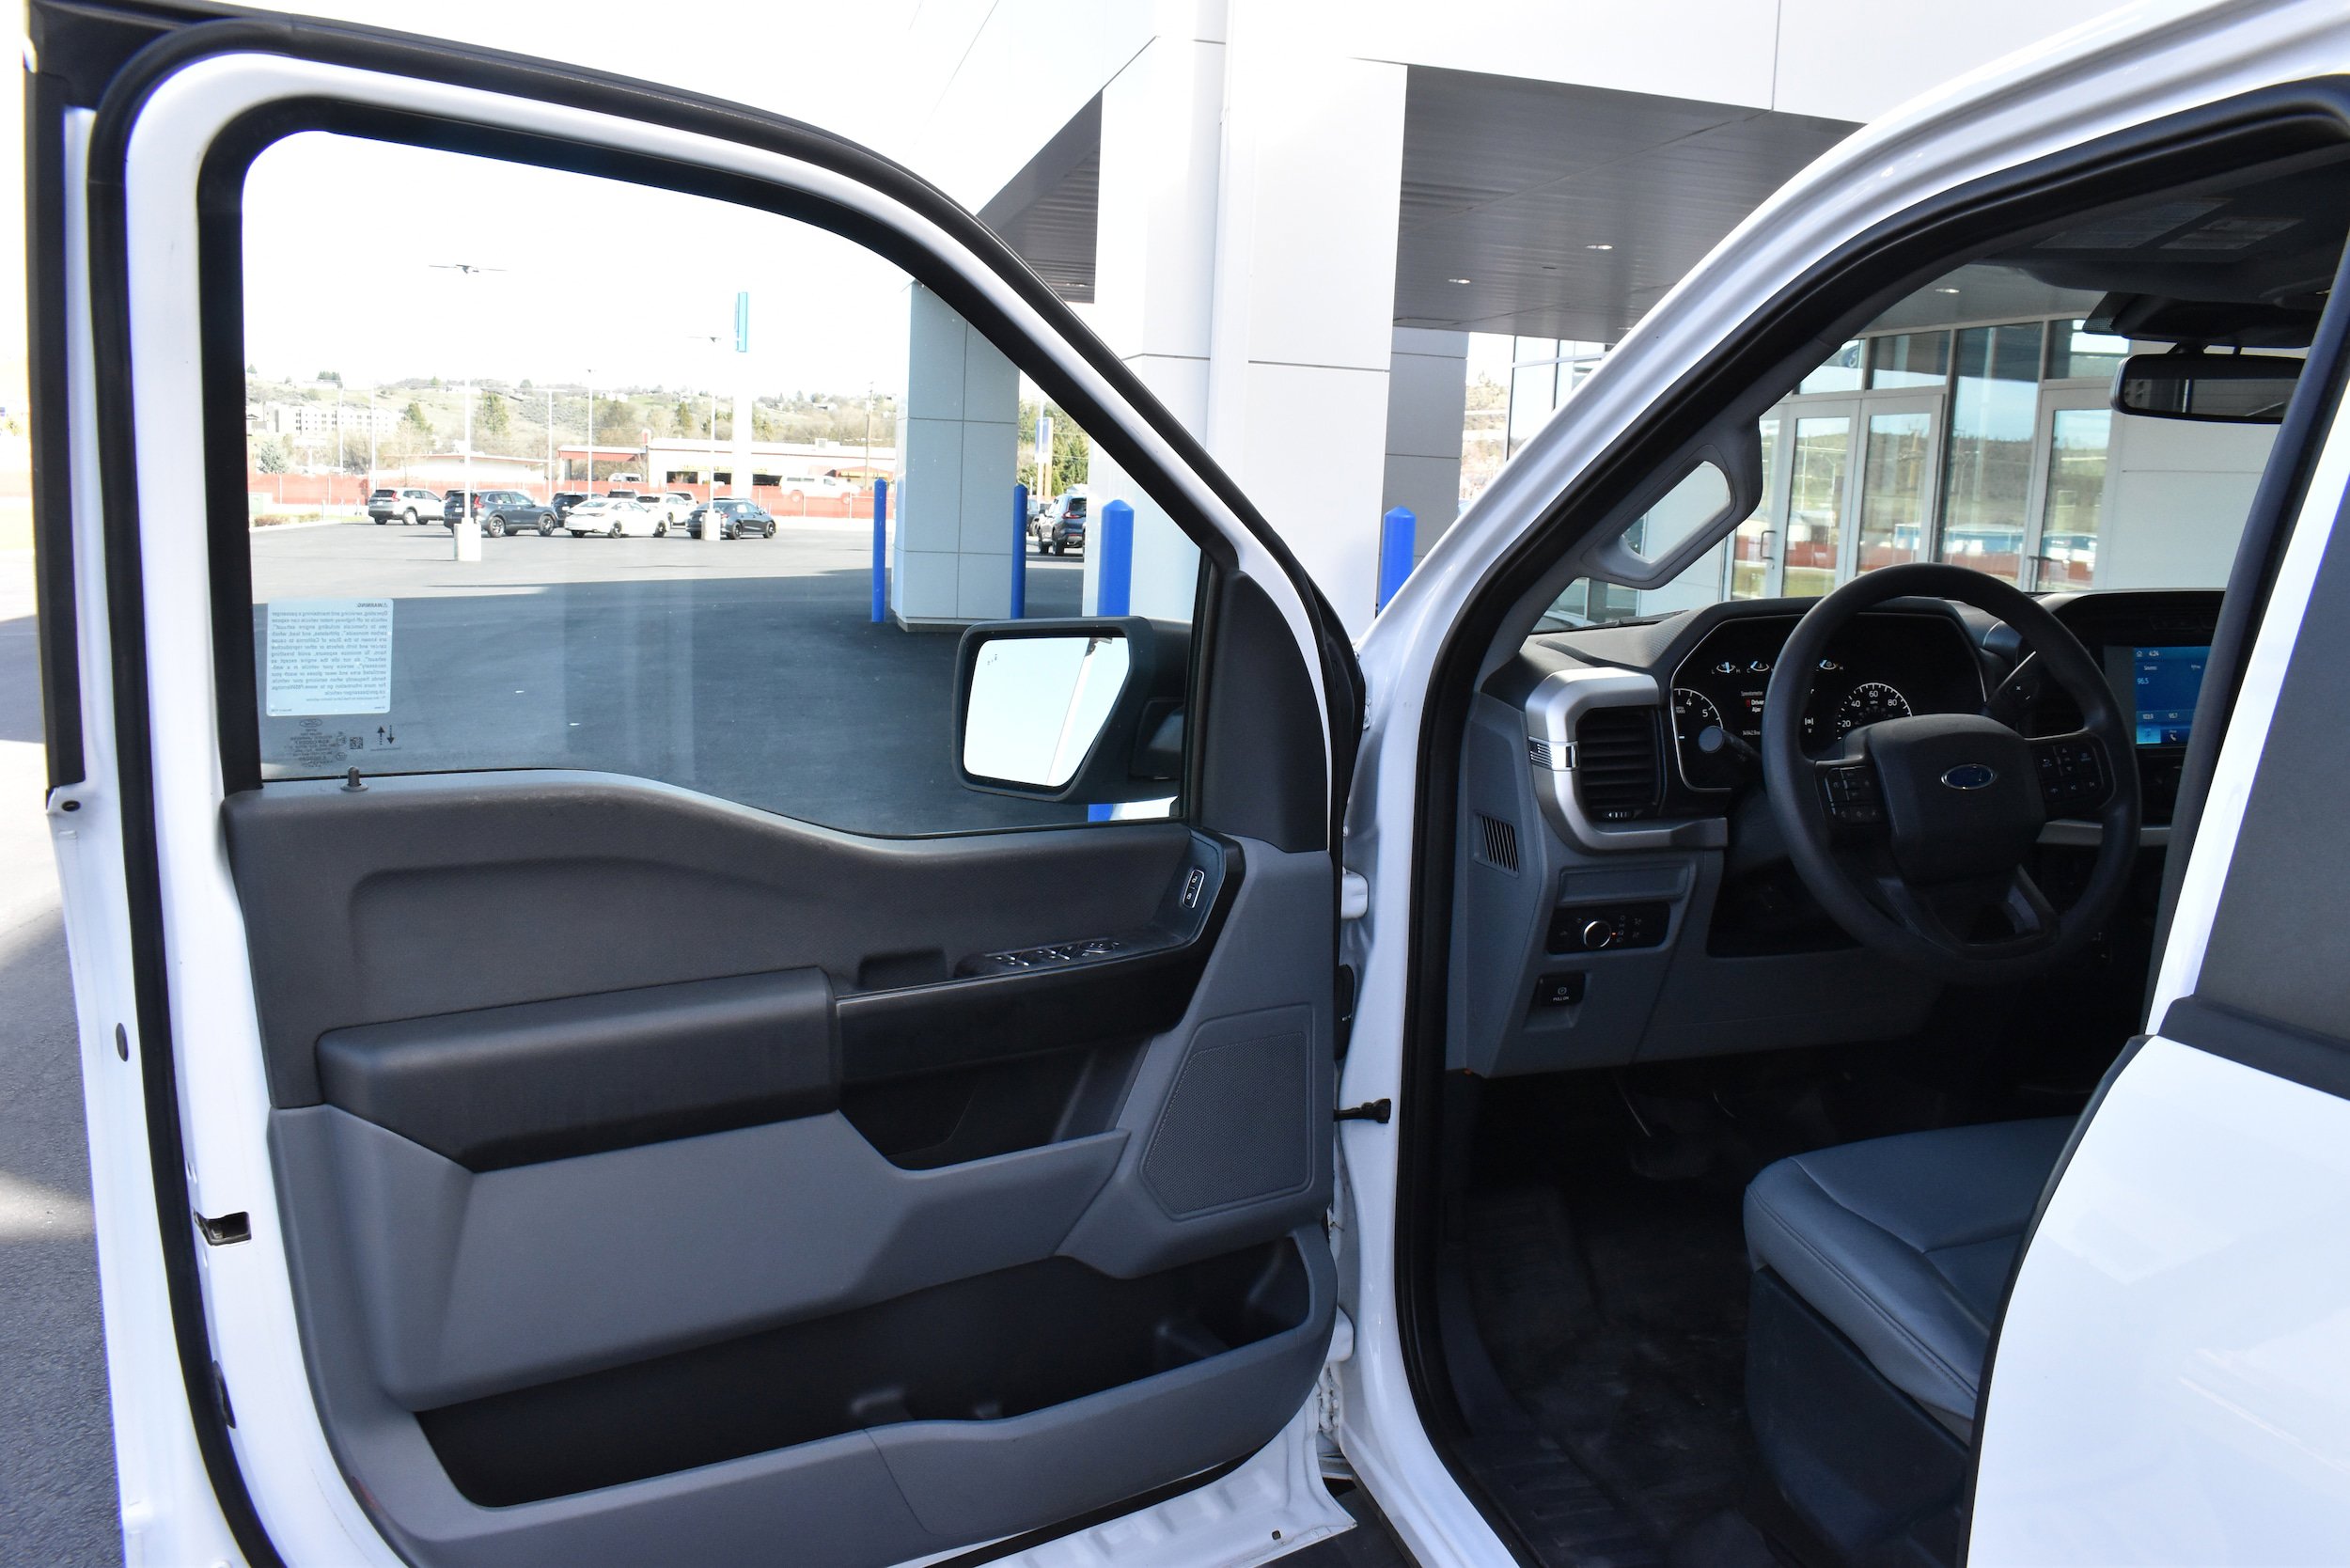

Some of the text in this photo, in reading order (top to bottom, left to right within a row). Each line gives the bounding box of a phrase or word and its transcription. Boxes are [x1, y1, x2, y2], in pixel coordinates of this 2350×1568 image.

[1850, 699, 1861, 708] 40
[1887, 698, 1898, 707] 80
[1702, 709, 1709, 717] 5
[1841, 719, 1851, 728] 20
